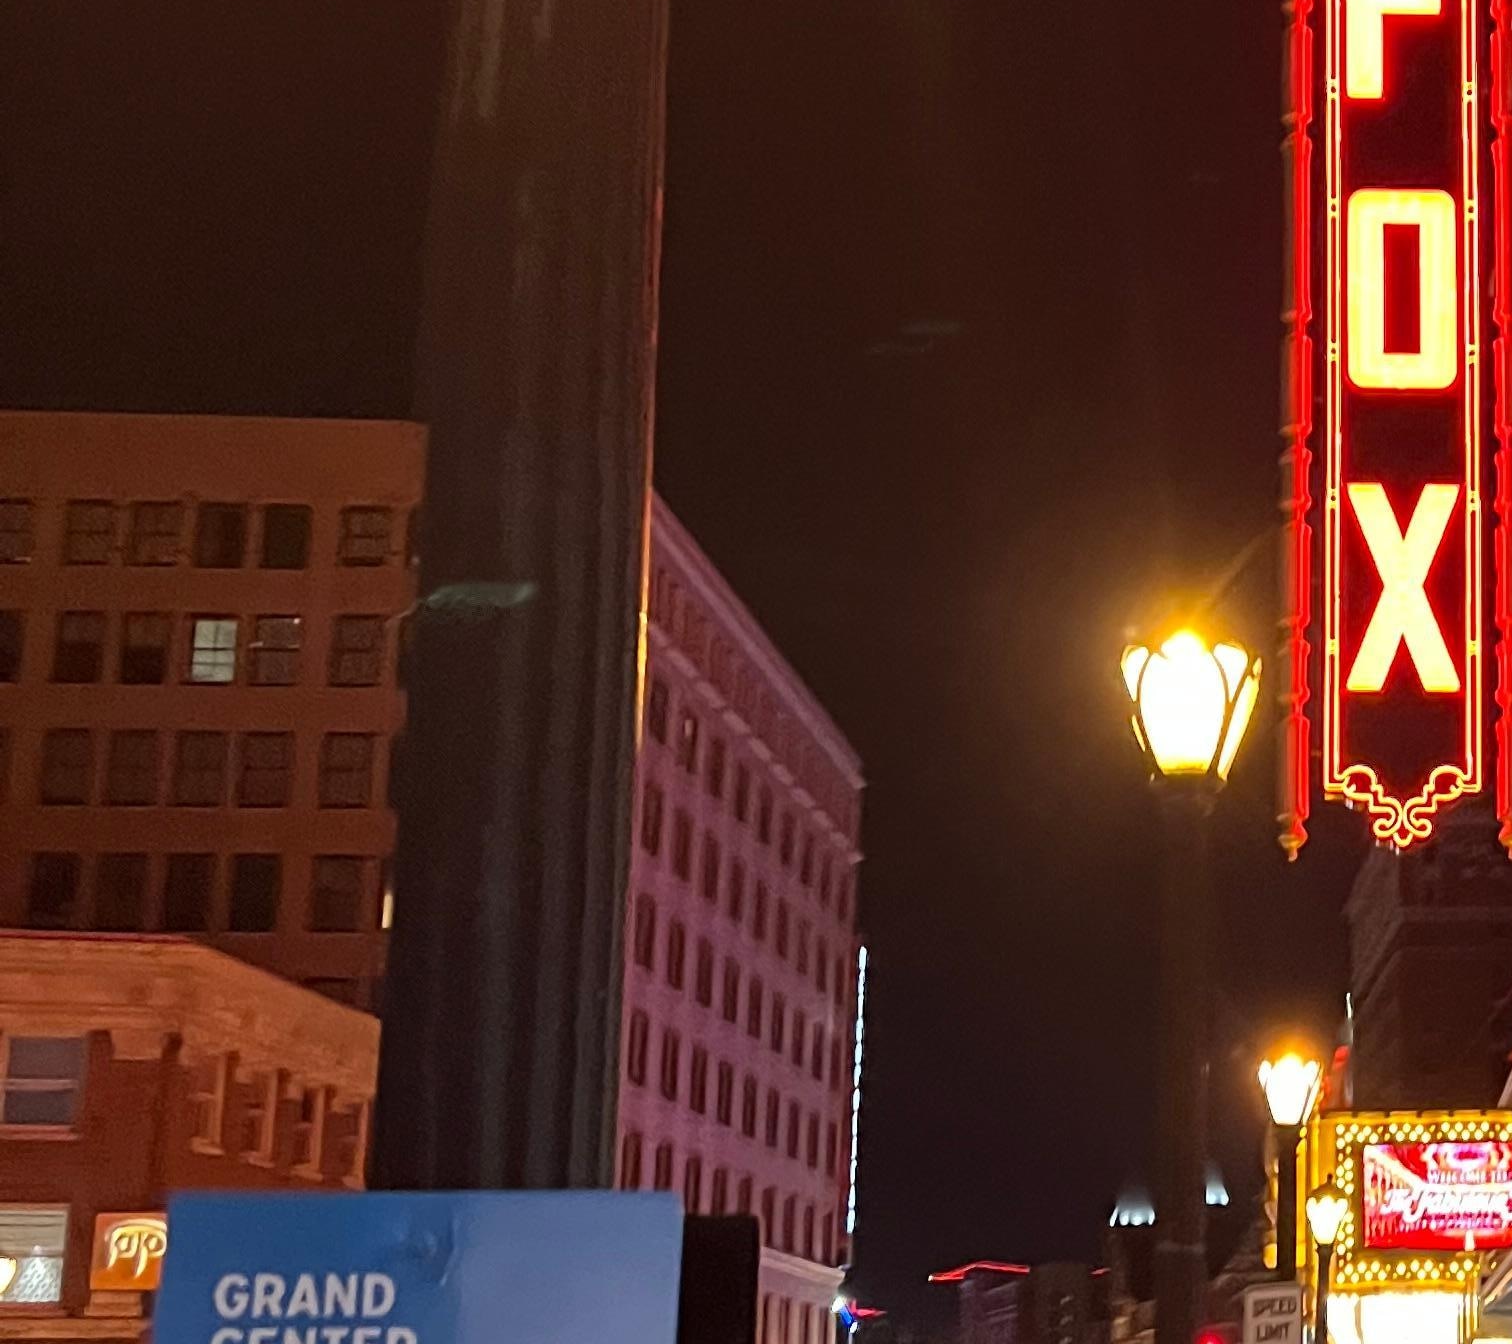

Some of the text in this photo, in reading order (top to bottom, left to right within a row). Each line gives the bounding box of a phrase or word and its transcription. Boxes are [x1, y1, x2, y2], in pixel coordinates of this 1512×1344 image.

[213, 1272, 396, 1320] GRAND
[1252, 1297, 1297, 1317] SPEED
[1256, 1322, 1291, 1342] LIMIT
